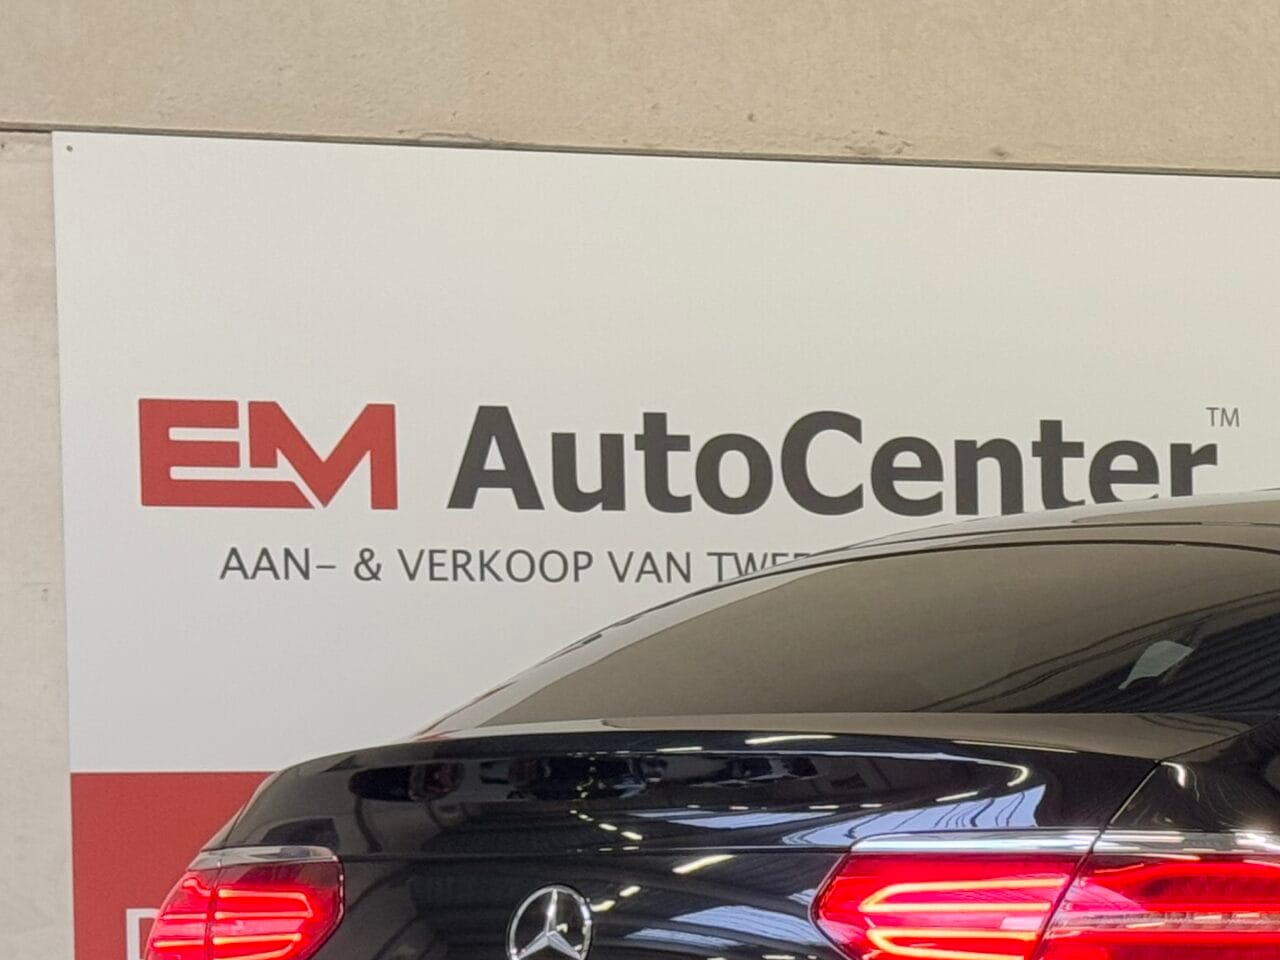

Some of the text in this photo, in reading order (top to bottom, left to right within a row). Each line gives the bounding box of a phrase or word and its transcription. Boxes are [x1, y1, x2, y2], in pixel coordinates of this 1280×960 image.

[138, 397, 399, 511] EM
[446, 404, 1218, 516] AutoCenter
[353, 547, 384, 583] &
[397, 548, 594, 584] VERKOOP
[607, 550, 693, 584] VAN
